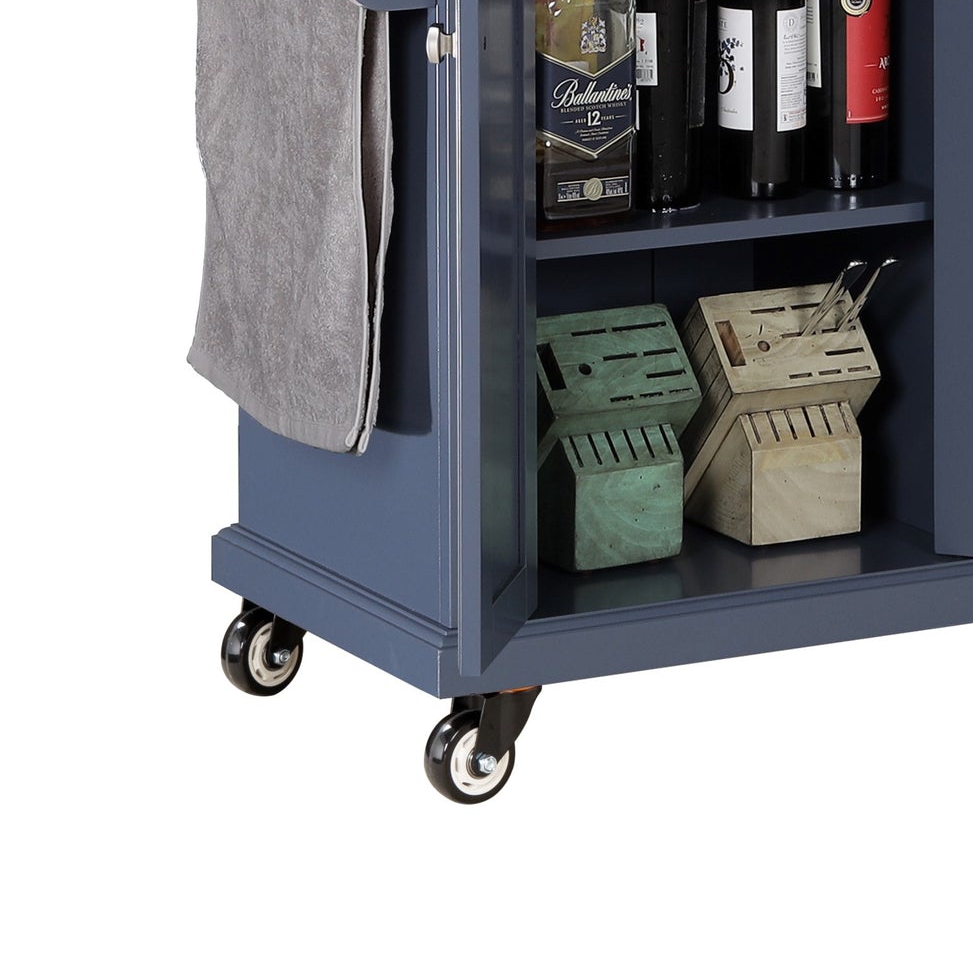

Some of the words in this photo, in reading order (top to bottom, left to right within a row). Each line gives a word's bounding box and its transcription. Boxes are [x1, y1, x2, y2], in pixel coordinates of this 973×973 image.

[551, 78, 633, 109] Ballantine's
[560, 106, 585, 114] BLENDED
[607, 101, 627, 109] WHISKY
[575, 117, 587, 125] AGED
[587, 110, 601, 126] 12
